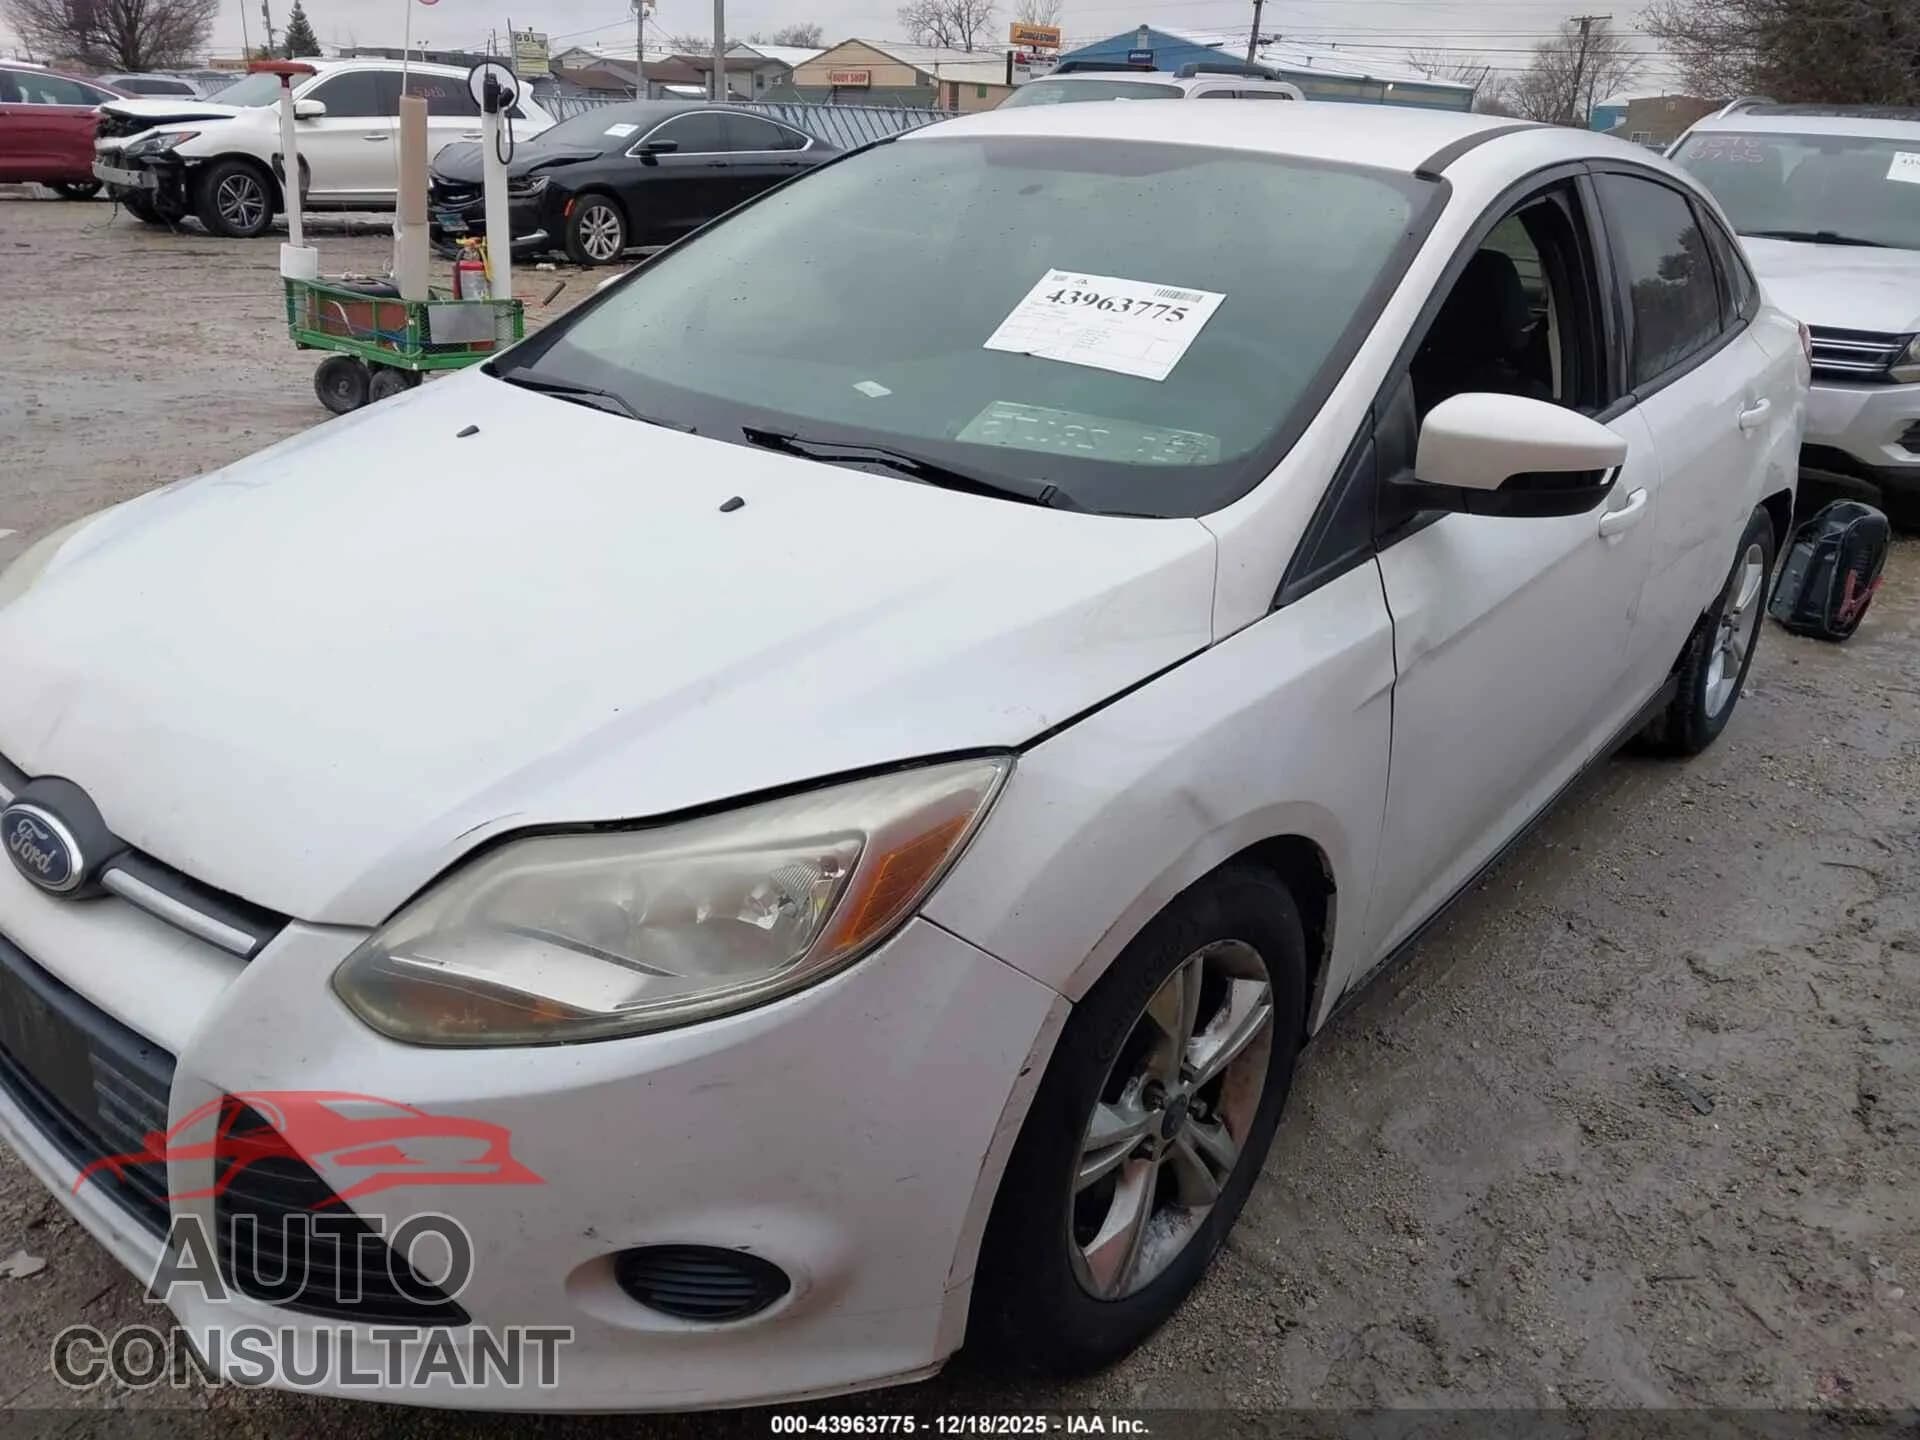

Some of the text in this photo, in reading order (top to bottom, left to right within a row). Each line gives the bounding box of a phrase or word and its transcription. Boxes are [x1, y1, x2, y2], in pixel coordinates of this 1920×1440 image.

[850, 73, 866, 82] SHOP
[1045, 288, 1190, 323] 43963775
[9, 818, 57, 874] Ford
